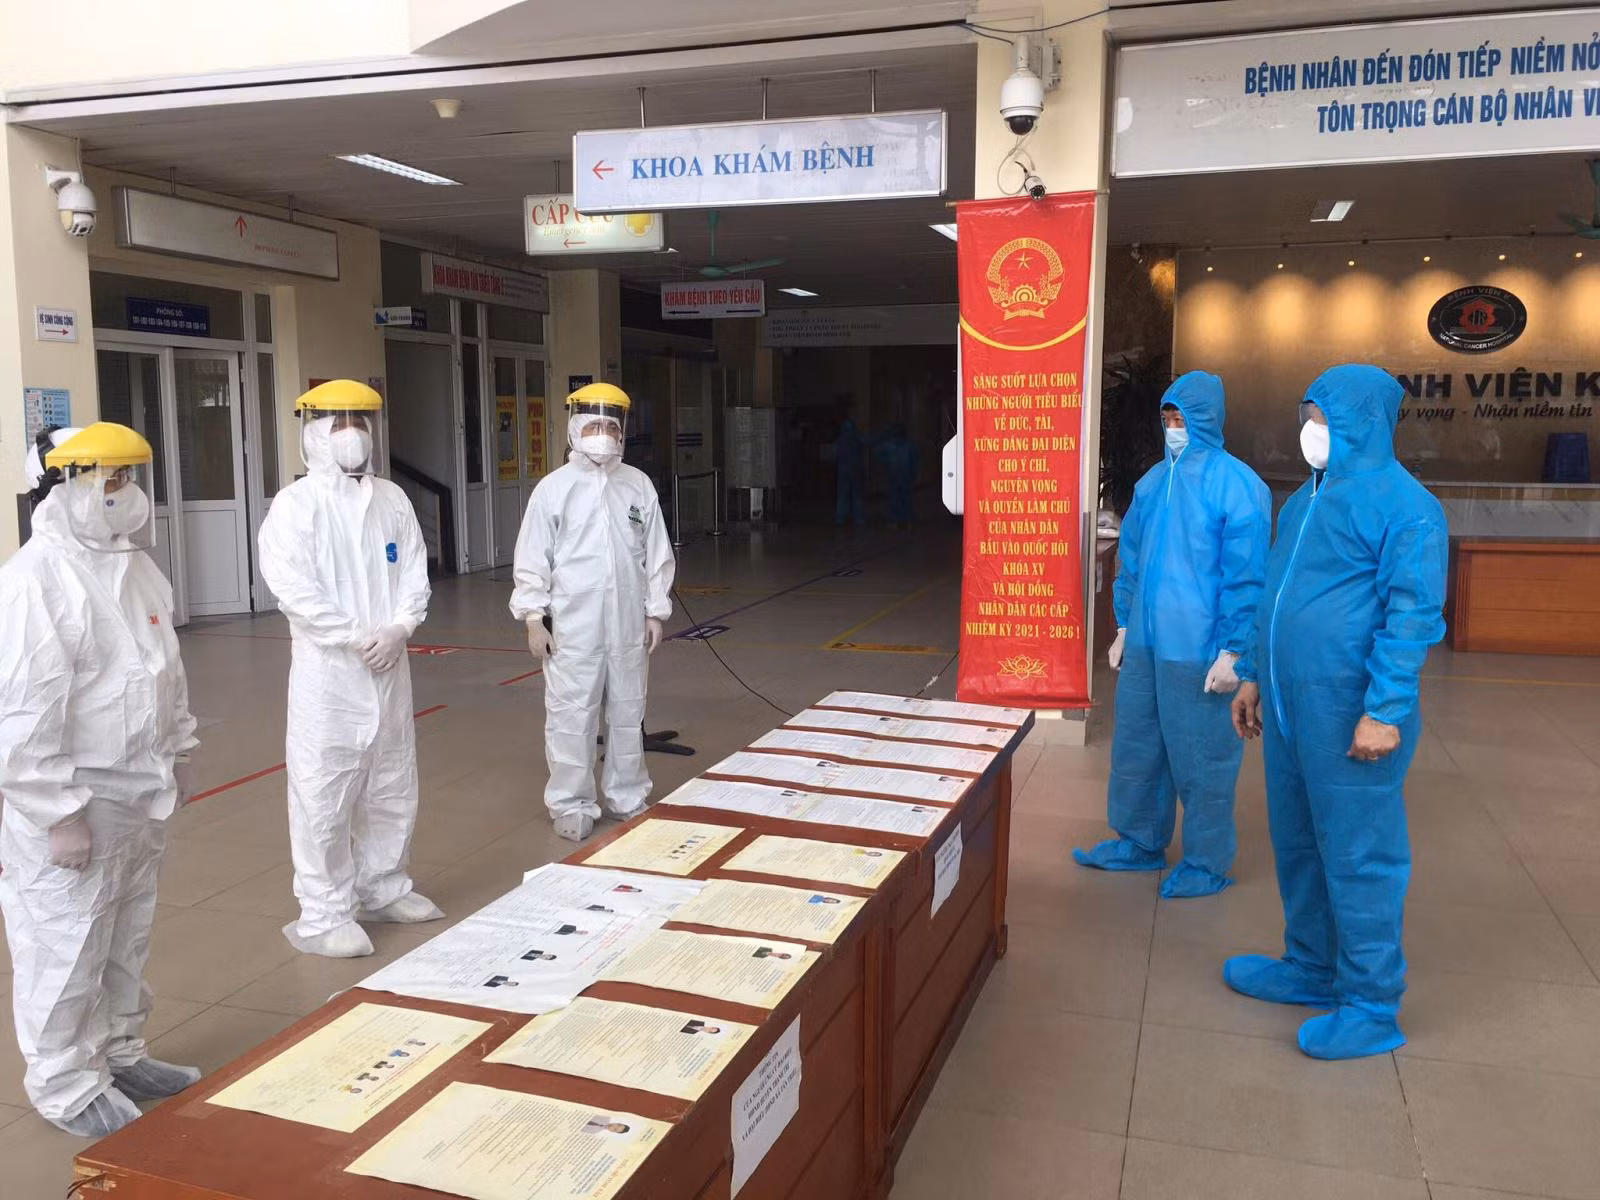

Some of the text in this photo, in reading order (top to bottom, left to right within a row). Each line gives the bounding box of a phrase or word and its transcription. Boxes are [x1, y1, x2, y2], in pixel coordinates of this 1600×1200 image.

[1245, 61, 1295, 98] BỆNH
[1302, 57, 1356, 89] NHÂN
[1363, 48, 1402, 85] ĐẾN
[1409, 48, 1450, 83] ĐÓN
[1458, 40, 1501, 79] TIẾP
[1511, 37, 1565, 75] NIỀM
[1318, 100, 1354, 133] TÔN
[1361, 100, 1426, 134] TRỌNG
[1433, 93, 1473, 125] CÁN
[1480, 88, 1507, 127] BỘ
[1514, 87, 1573, 120] NHÂN
[632, 141, 874, 179] KHOA KHÁM BỆNH
[531, 198, 570, 226] CẤP
[665, 283, 760, 307] KHÁM BỆNH THEO YÊU CẦU
[973, 371, 1077, 390] SÁNG SUỐT LỰA CHỌN
[1397, 367, 1600, 401] NH VIỆN K
[967, 394, 998, 410] NHỮNG
[1002, 394, 1032, 409] NGƯỜI
[1035, 392, 1057, 408] TIÊU
[1416, 408, 1455, 422] vọng
[1474, 404, 1519, 421] Nhận
[1523, 401, 1564, 417] niềm
[1569, 402, 1592, 417] tin
[994, 413, 1054, 431] VỀ ĐỨC, TÀI,
[975, 434, 1075, 453] XỨNG ĐÁNG ĐẠI DIỆN
[998, 455, 1049, 472] CHO Ý CHÍ,
[991, 477, 1057, 494] NGUYỆN VỌNG
[979, 496, 1070, 514] VÀ QUYỀN LÀM CHỦ
[989, 518, 1058, 534] CỦA NHÂN DÂN
[980, 538, 1068, 556] BẦU VÀO QUỐC HỘI
[1003, 560, 1044, 575] KHÓA XV
[993, 580, 1053, 598] VÀ HỘI ĐỒNG
[979, 600, 1068, 617] NHÂN DÂN CÁC CẤP
[966, 620, 996, 637] NHIỆM
[999, 621, 1012, 636] KỲ
[1015, 624, 1039, 637] 2021
[1050, 626, 1073, 638] 2026
